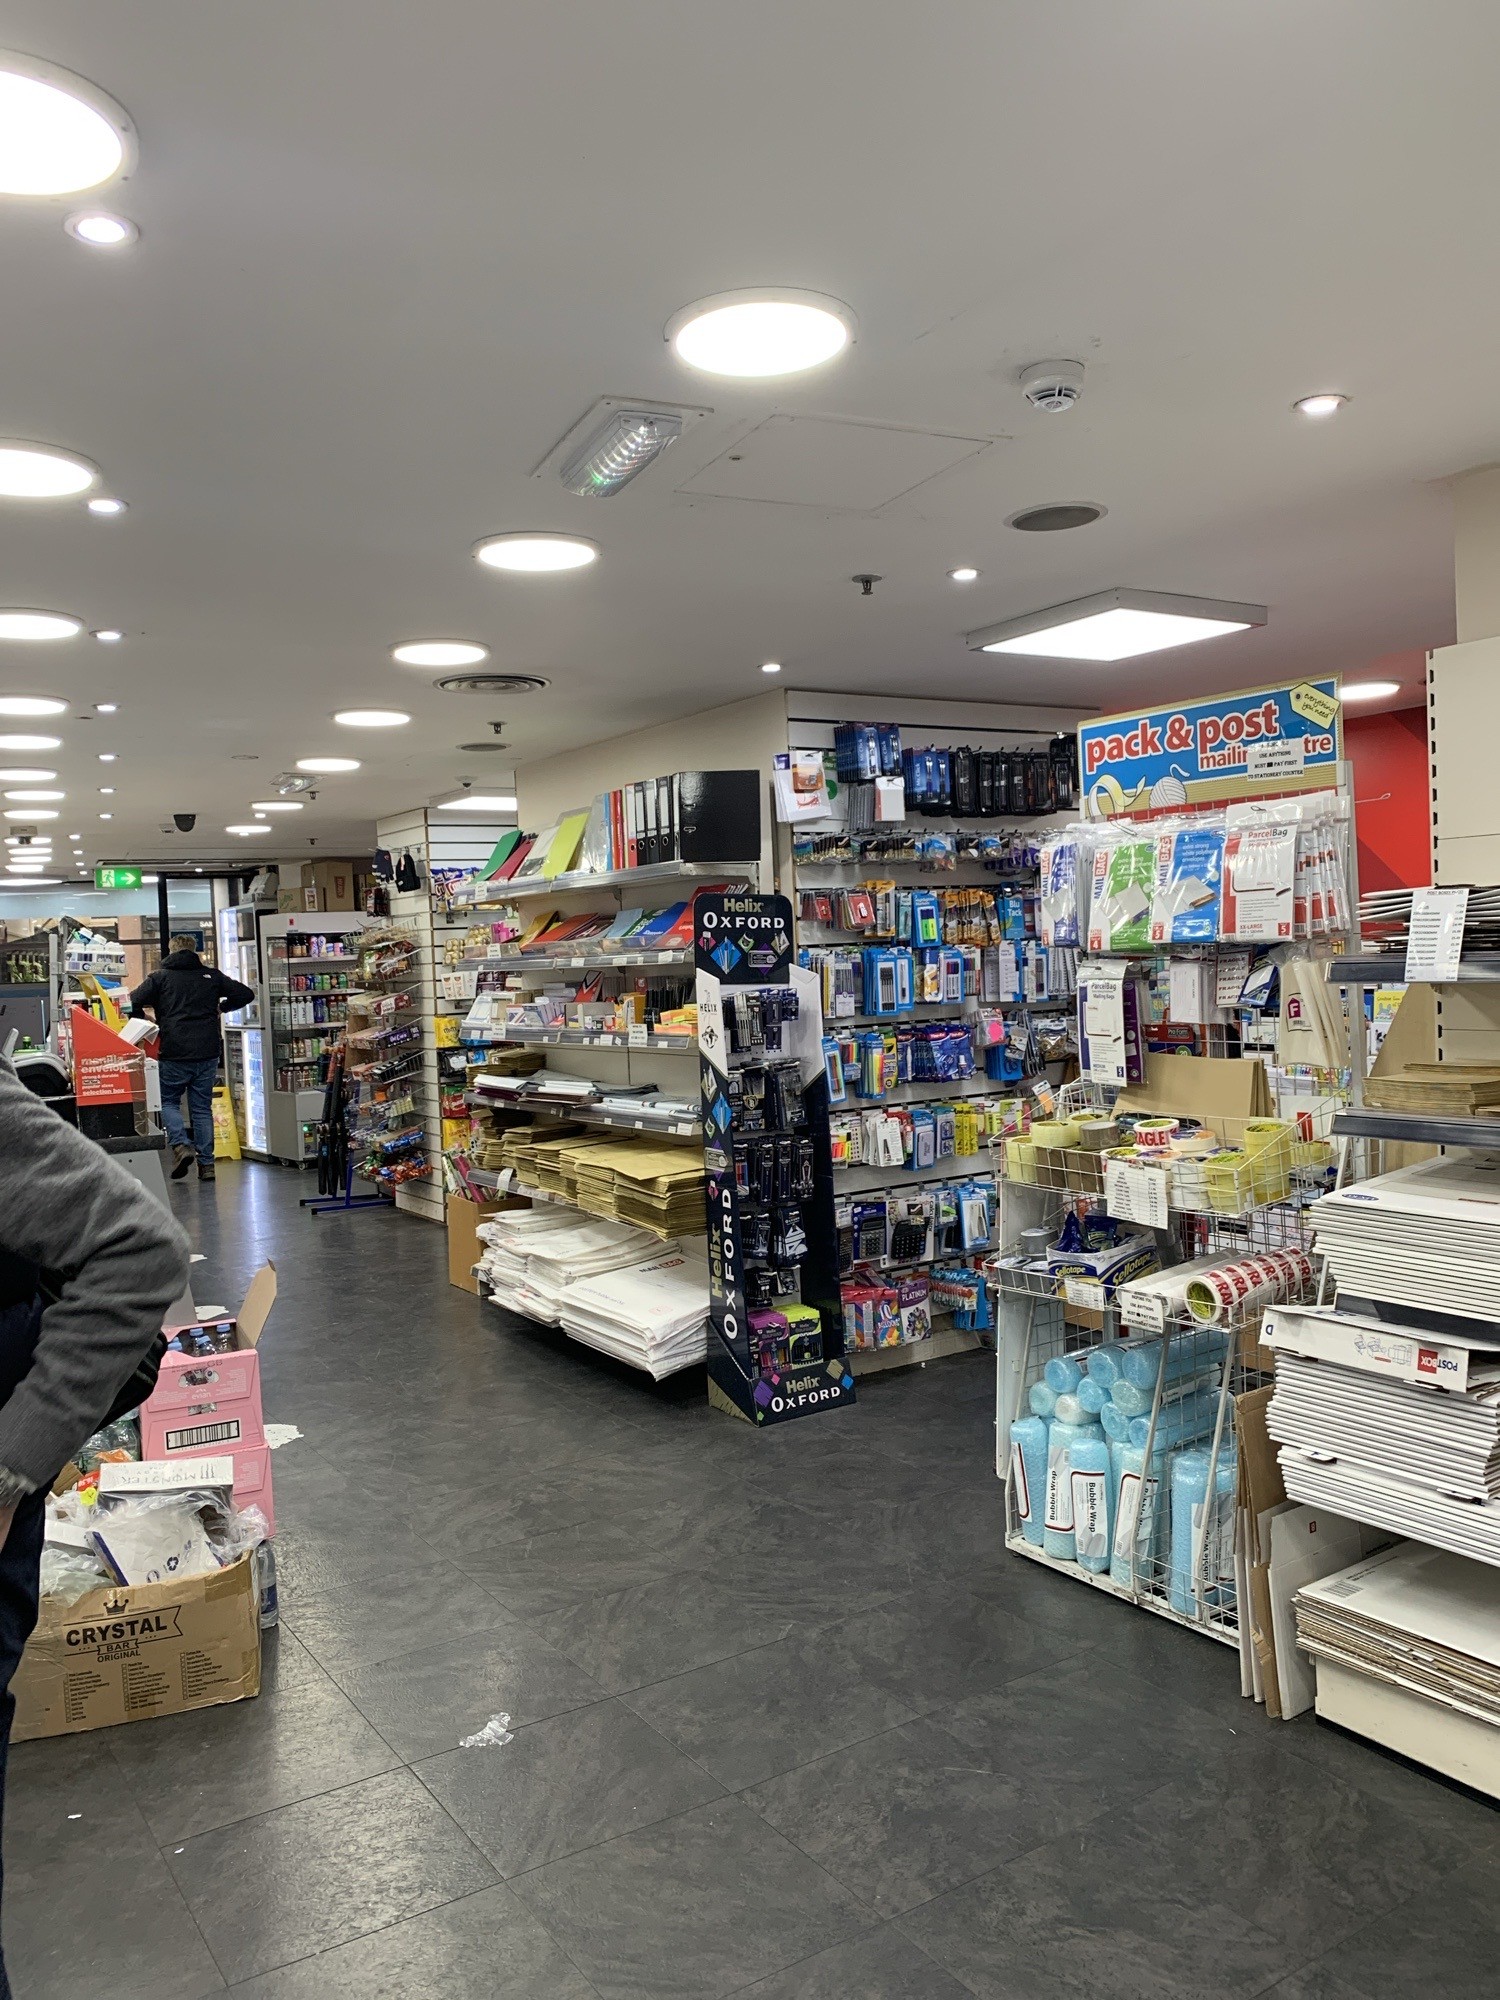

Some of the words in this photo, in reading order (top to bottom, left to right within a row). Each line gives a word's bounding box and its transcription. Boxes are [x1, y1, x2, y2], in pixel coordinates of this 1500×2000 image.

[1302, 702, 1314, 712] you
[1315, 709, 1329, 719] need
[1304, 693, 1335, 715] everything
[1087, 722, 1161, 773] pack
[1166, 716, 1194, 751] &
[1199, 703, 1279, 754] post
[1201, 747, 1248, 769] maili
[1303, 736, 1332, 754] tre
[1160, 837, 1172, 860] BAG
[1096, 852, 1108, 875] BAG
[1159, 864, 1169, 887] MAIL
[1094, 877, 1104, 900] MAIL
[723, 897, 762, 913] Helix
[1007, 908, 1022, 917] Tack
[1009, 900, 1020, 908] Blu
[703, 911, 785, 929] OXFORD
[1091, 982, 1116, 991] ParcelBag
[699, 1003, 717, 1012] HELIX
[711, 1225, 723, 1298] Helix
[722, 1188, 738, 1339] OXFORD
[1055, 1266, 1087, 1277] Sellotape
[1112, 1250, 1151, 1285] Sellotape
[901, 1289, 927, 1301] PLATINUM
[1420, 1355, 1459, 1372] POSTBOX
[785, 1374, 820, 1394] Helix
[192, 1391, 212, 1400] evian
[771, 1386, 841, 1413] OXFORD
[1050, 1470, 1058, 1491] Wrap
[1088, 1482, 1096, 1510] Bubble
[1049, 1493, 1057, 1521] Bubble
[1088, 1511, 1097, 1533] Wrap
[66, 1615, 168, 1647] CRYSTAL
[97, 1649, 141, 1663] ORIGINAL
[106, 1642, 130, 1653] BAR
